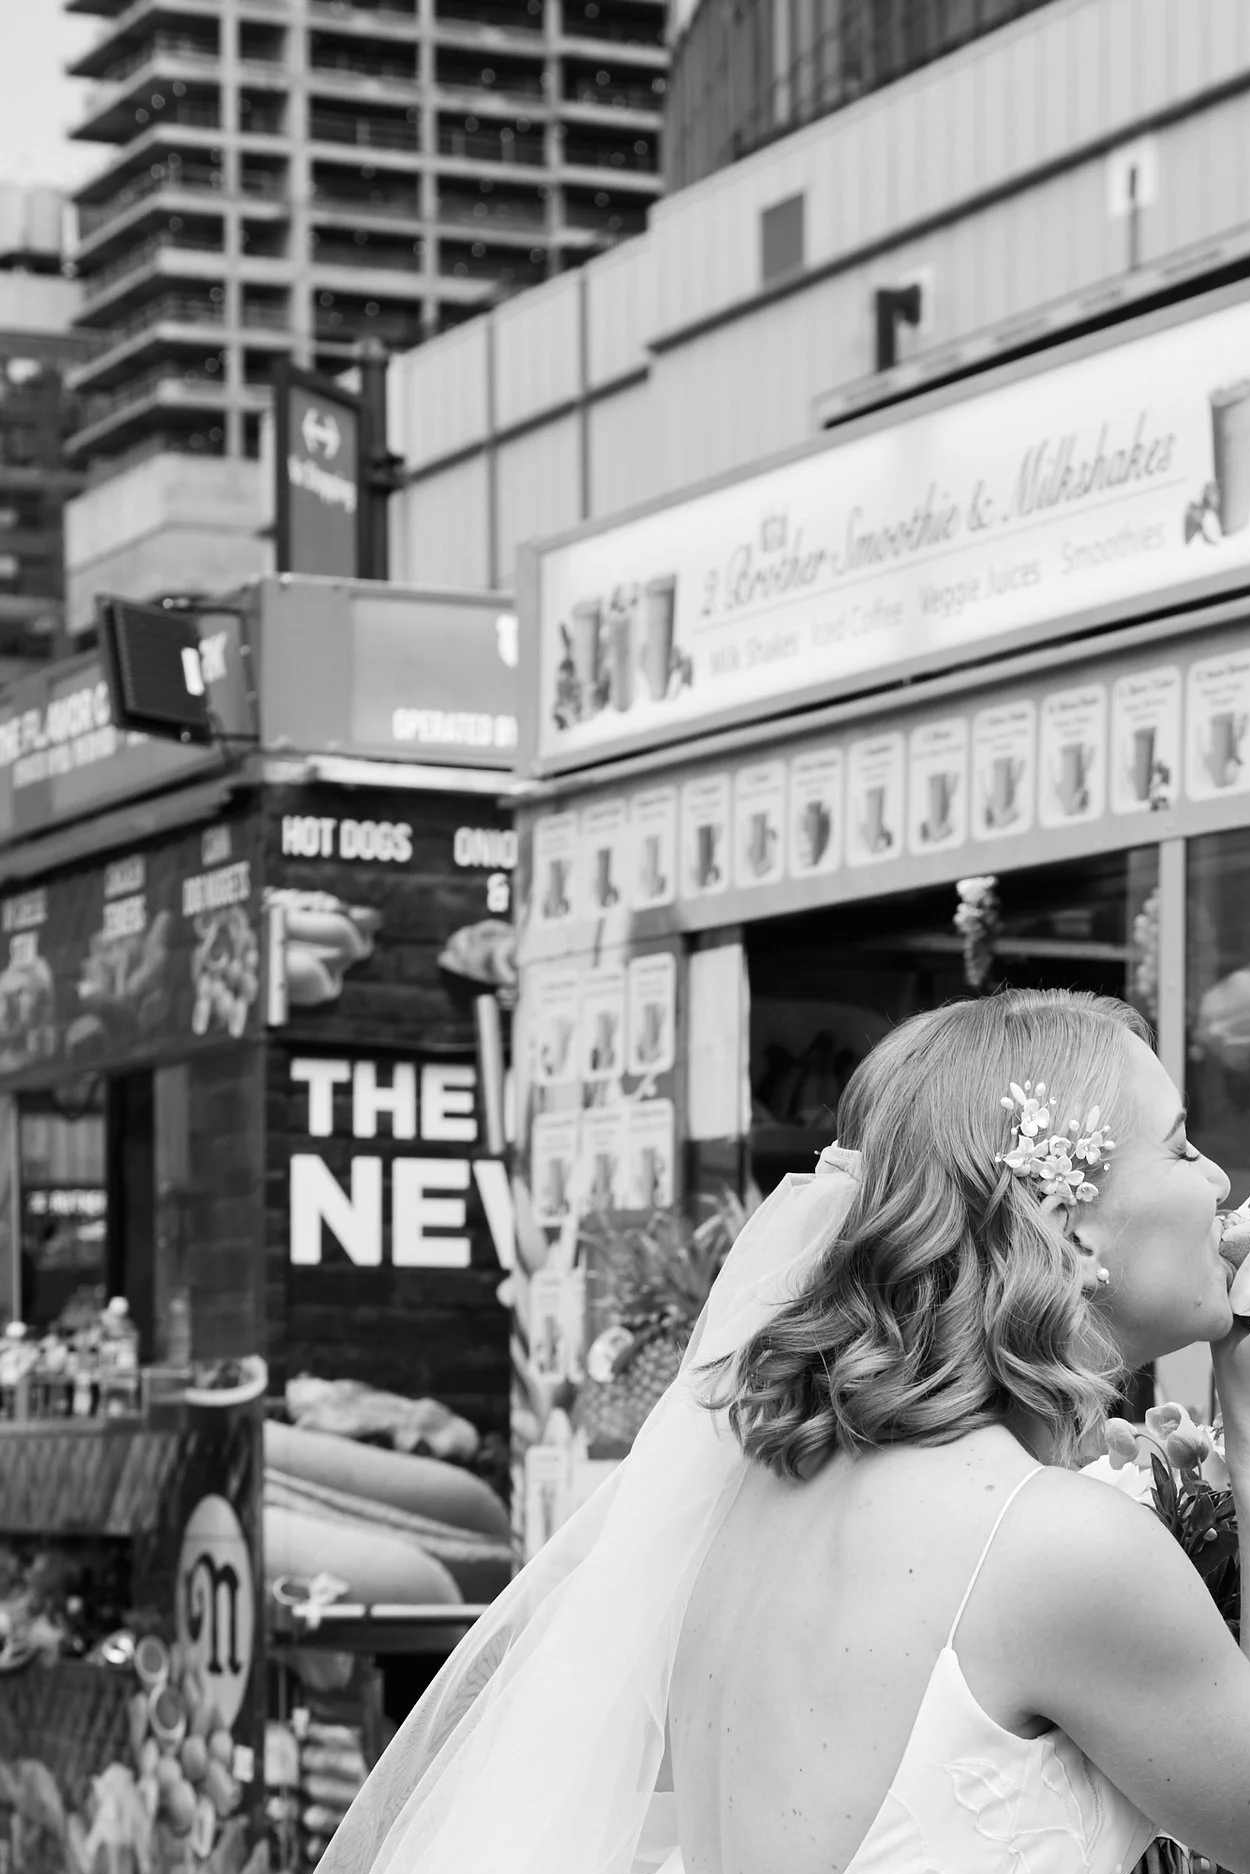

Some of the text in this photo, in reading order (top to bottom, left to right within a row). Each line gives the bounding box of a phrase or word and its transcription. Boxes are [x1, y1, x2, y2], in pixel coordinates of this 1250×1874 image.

[282, 816, 333, 858] HOT
[339, 818, 412, 862] DOGS
[291, 1058, 477, 1142] THE
